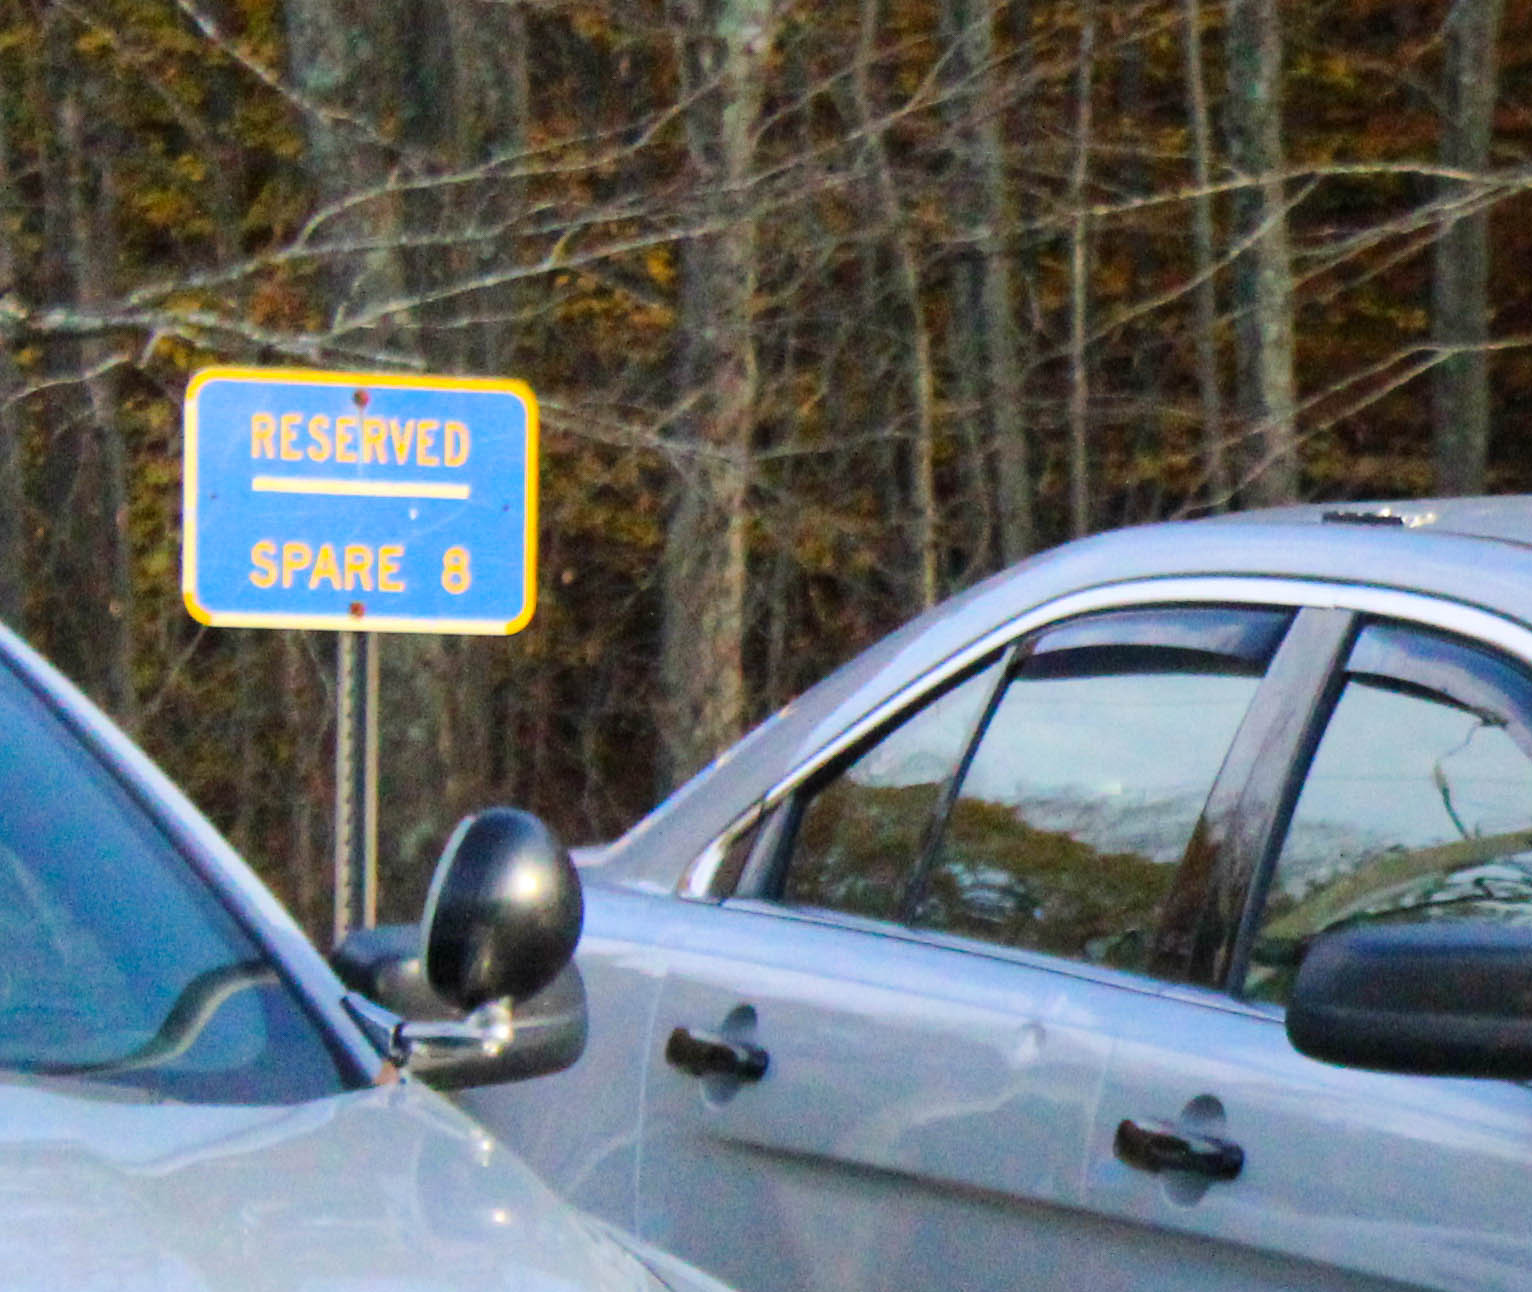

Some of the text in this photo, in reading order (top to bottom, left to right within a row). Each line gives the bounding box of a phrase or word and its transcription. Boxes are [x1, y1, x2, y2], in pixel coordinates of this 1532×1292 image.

[250, 412, 471, 467] RESERVED
[249, 539, 471, 594] SPARE 8
